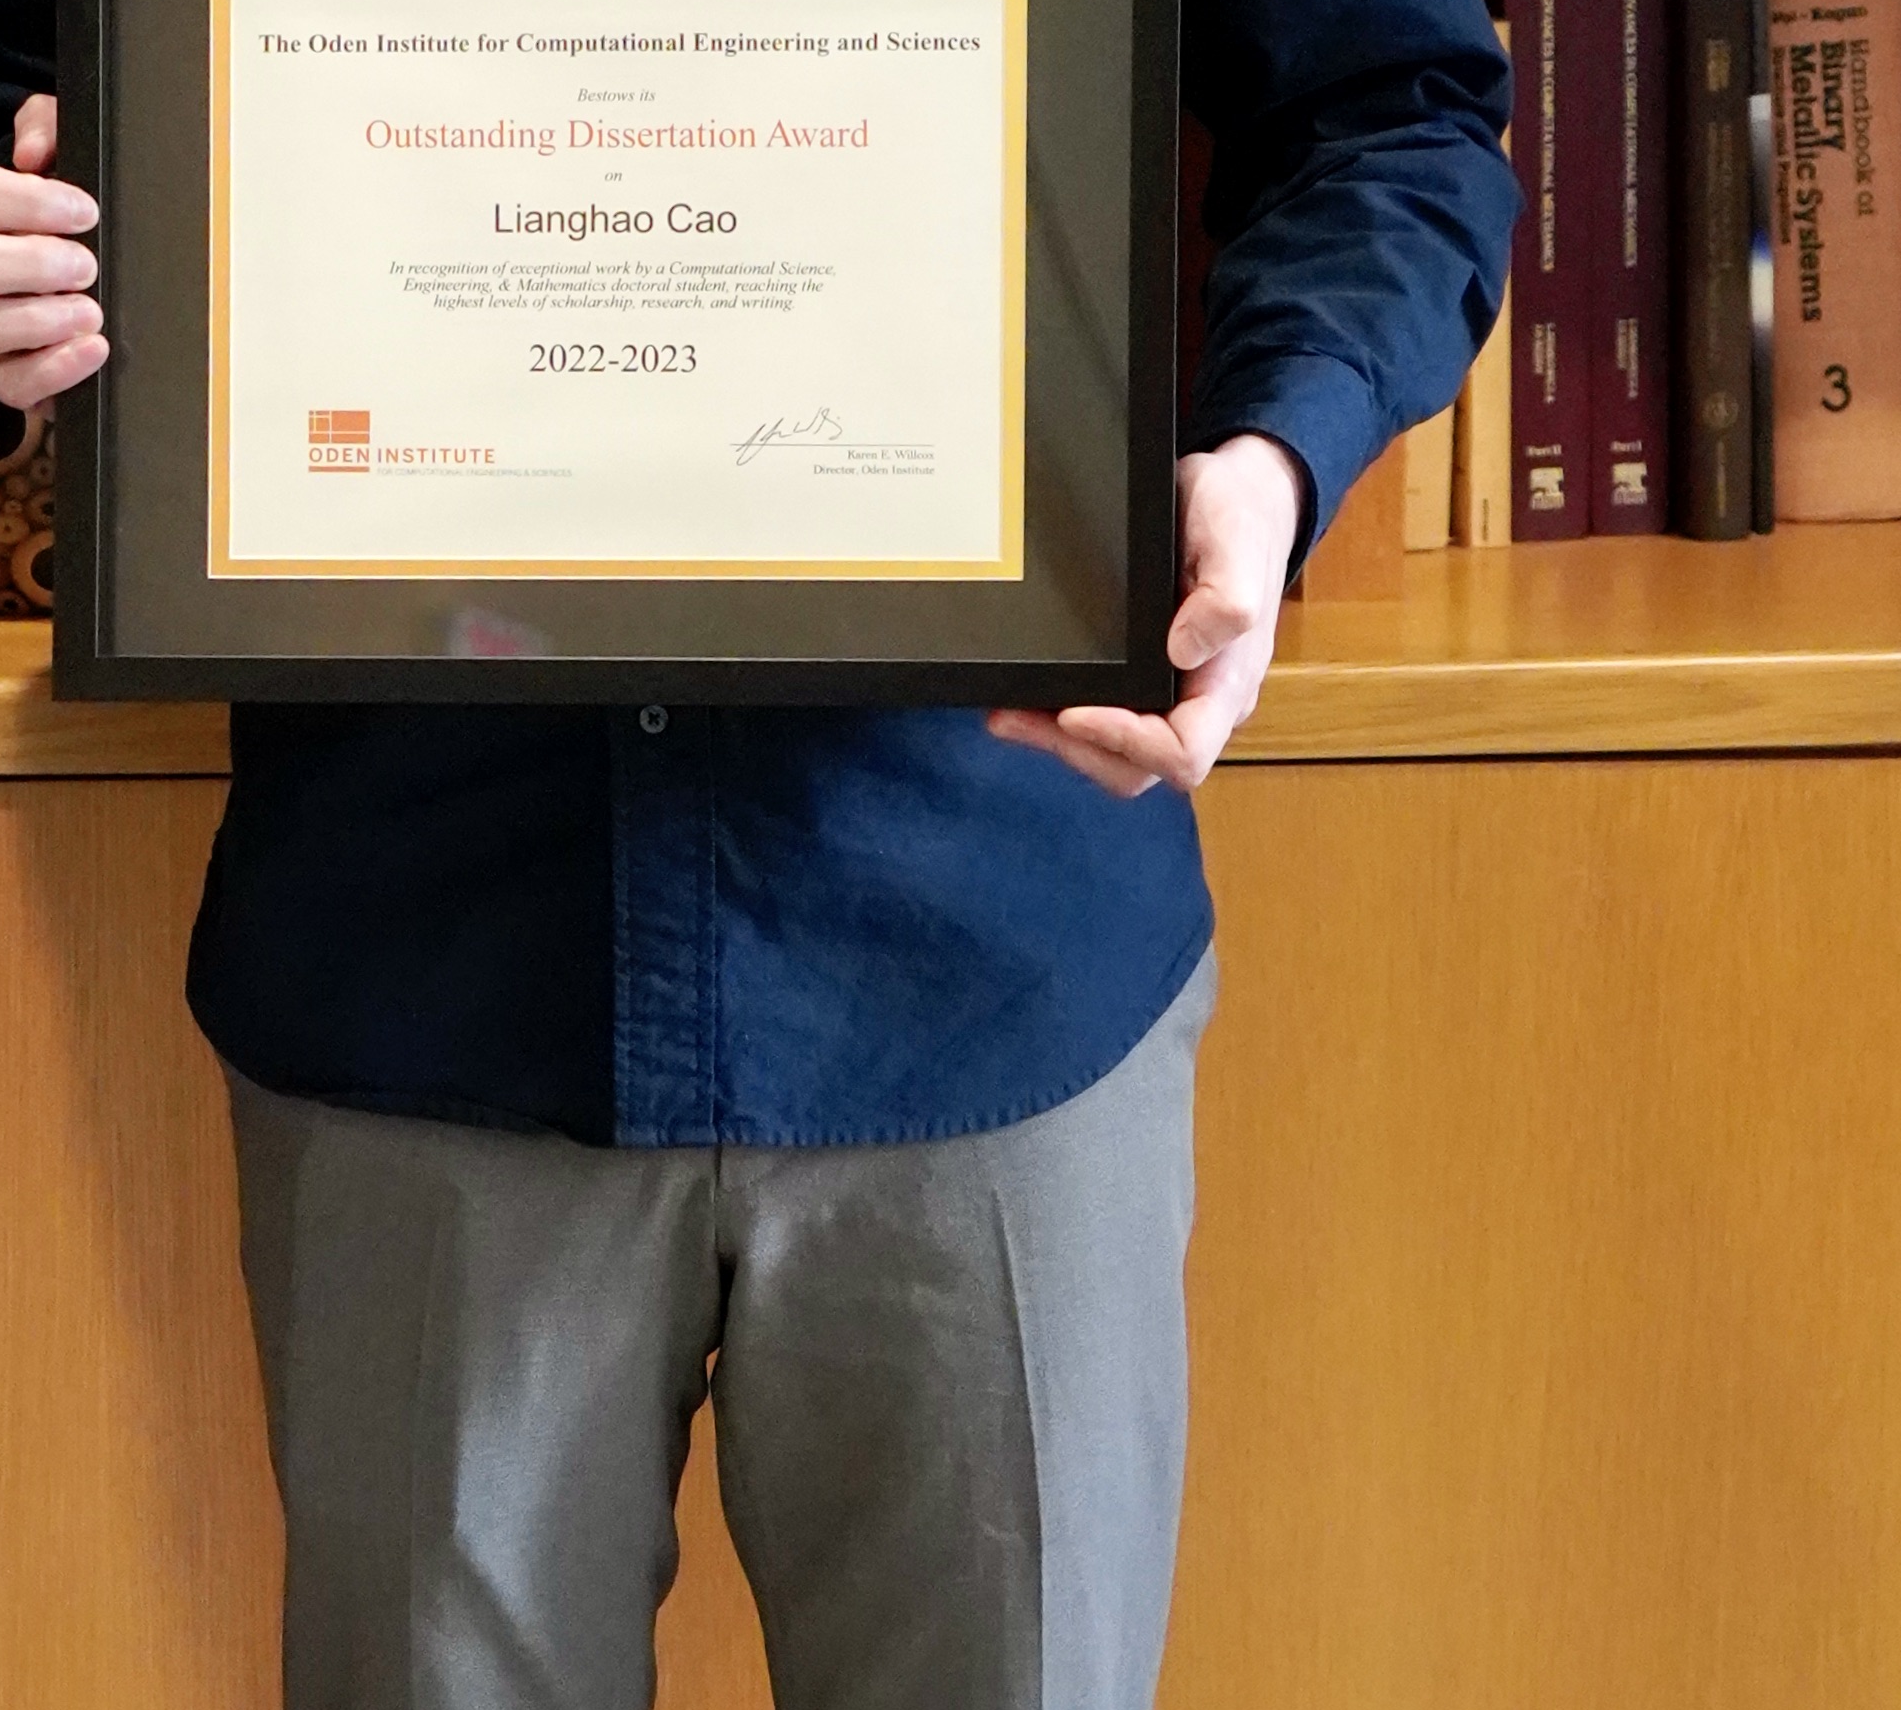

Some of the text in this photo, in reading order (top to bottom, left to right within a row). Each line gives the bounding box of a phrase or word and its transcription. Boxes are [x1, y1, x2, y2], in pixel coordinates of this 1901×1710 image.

[258, 31, 981, 58] The Oden Institute for Computational Engineering and Sciences
[577, 88, 656, 103] Bestows its
[1816, 40, 1848, 151] Binary
[1849, 38, 1876, 183] Handbook
[365, 118, 869, 157] Outstanding Dissertation Award
[604, 171, 623, 183] on
[1790, 42, 1825, 322] Metallic Systems
[494, 202, 738, 242] Lianghao Cao
[389, 260, 837, 278] In recognition of exceptional work by a Computational Science,
[403, 277, 824, 294] Engineering, & Mathematics doctoral student, reaching the
[433, 293, 797, 312] highest levels of scholarship, research, and writing.
[528, 343, 697, 374] 2022-2023
[1820, 363, 1853, 412] 3
[308, 447, 496, 465] ODEN INSTITUTE
[847, 449, 935, 461] Karen E. Willcox
[813, 464, 935, 477] Director, Oden Institute
